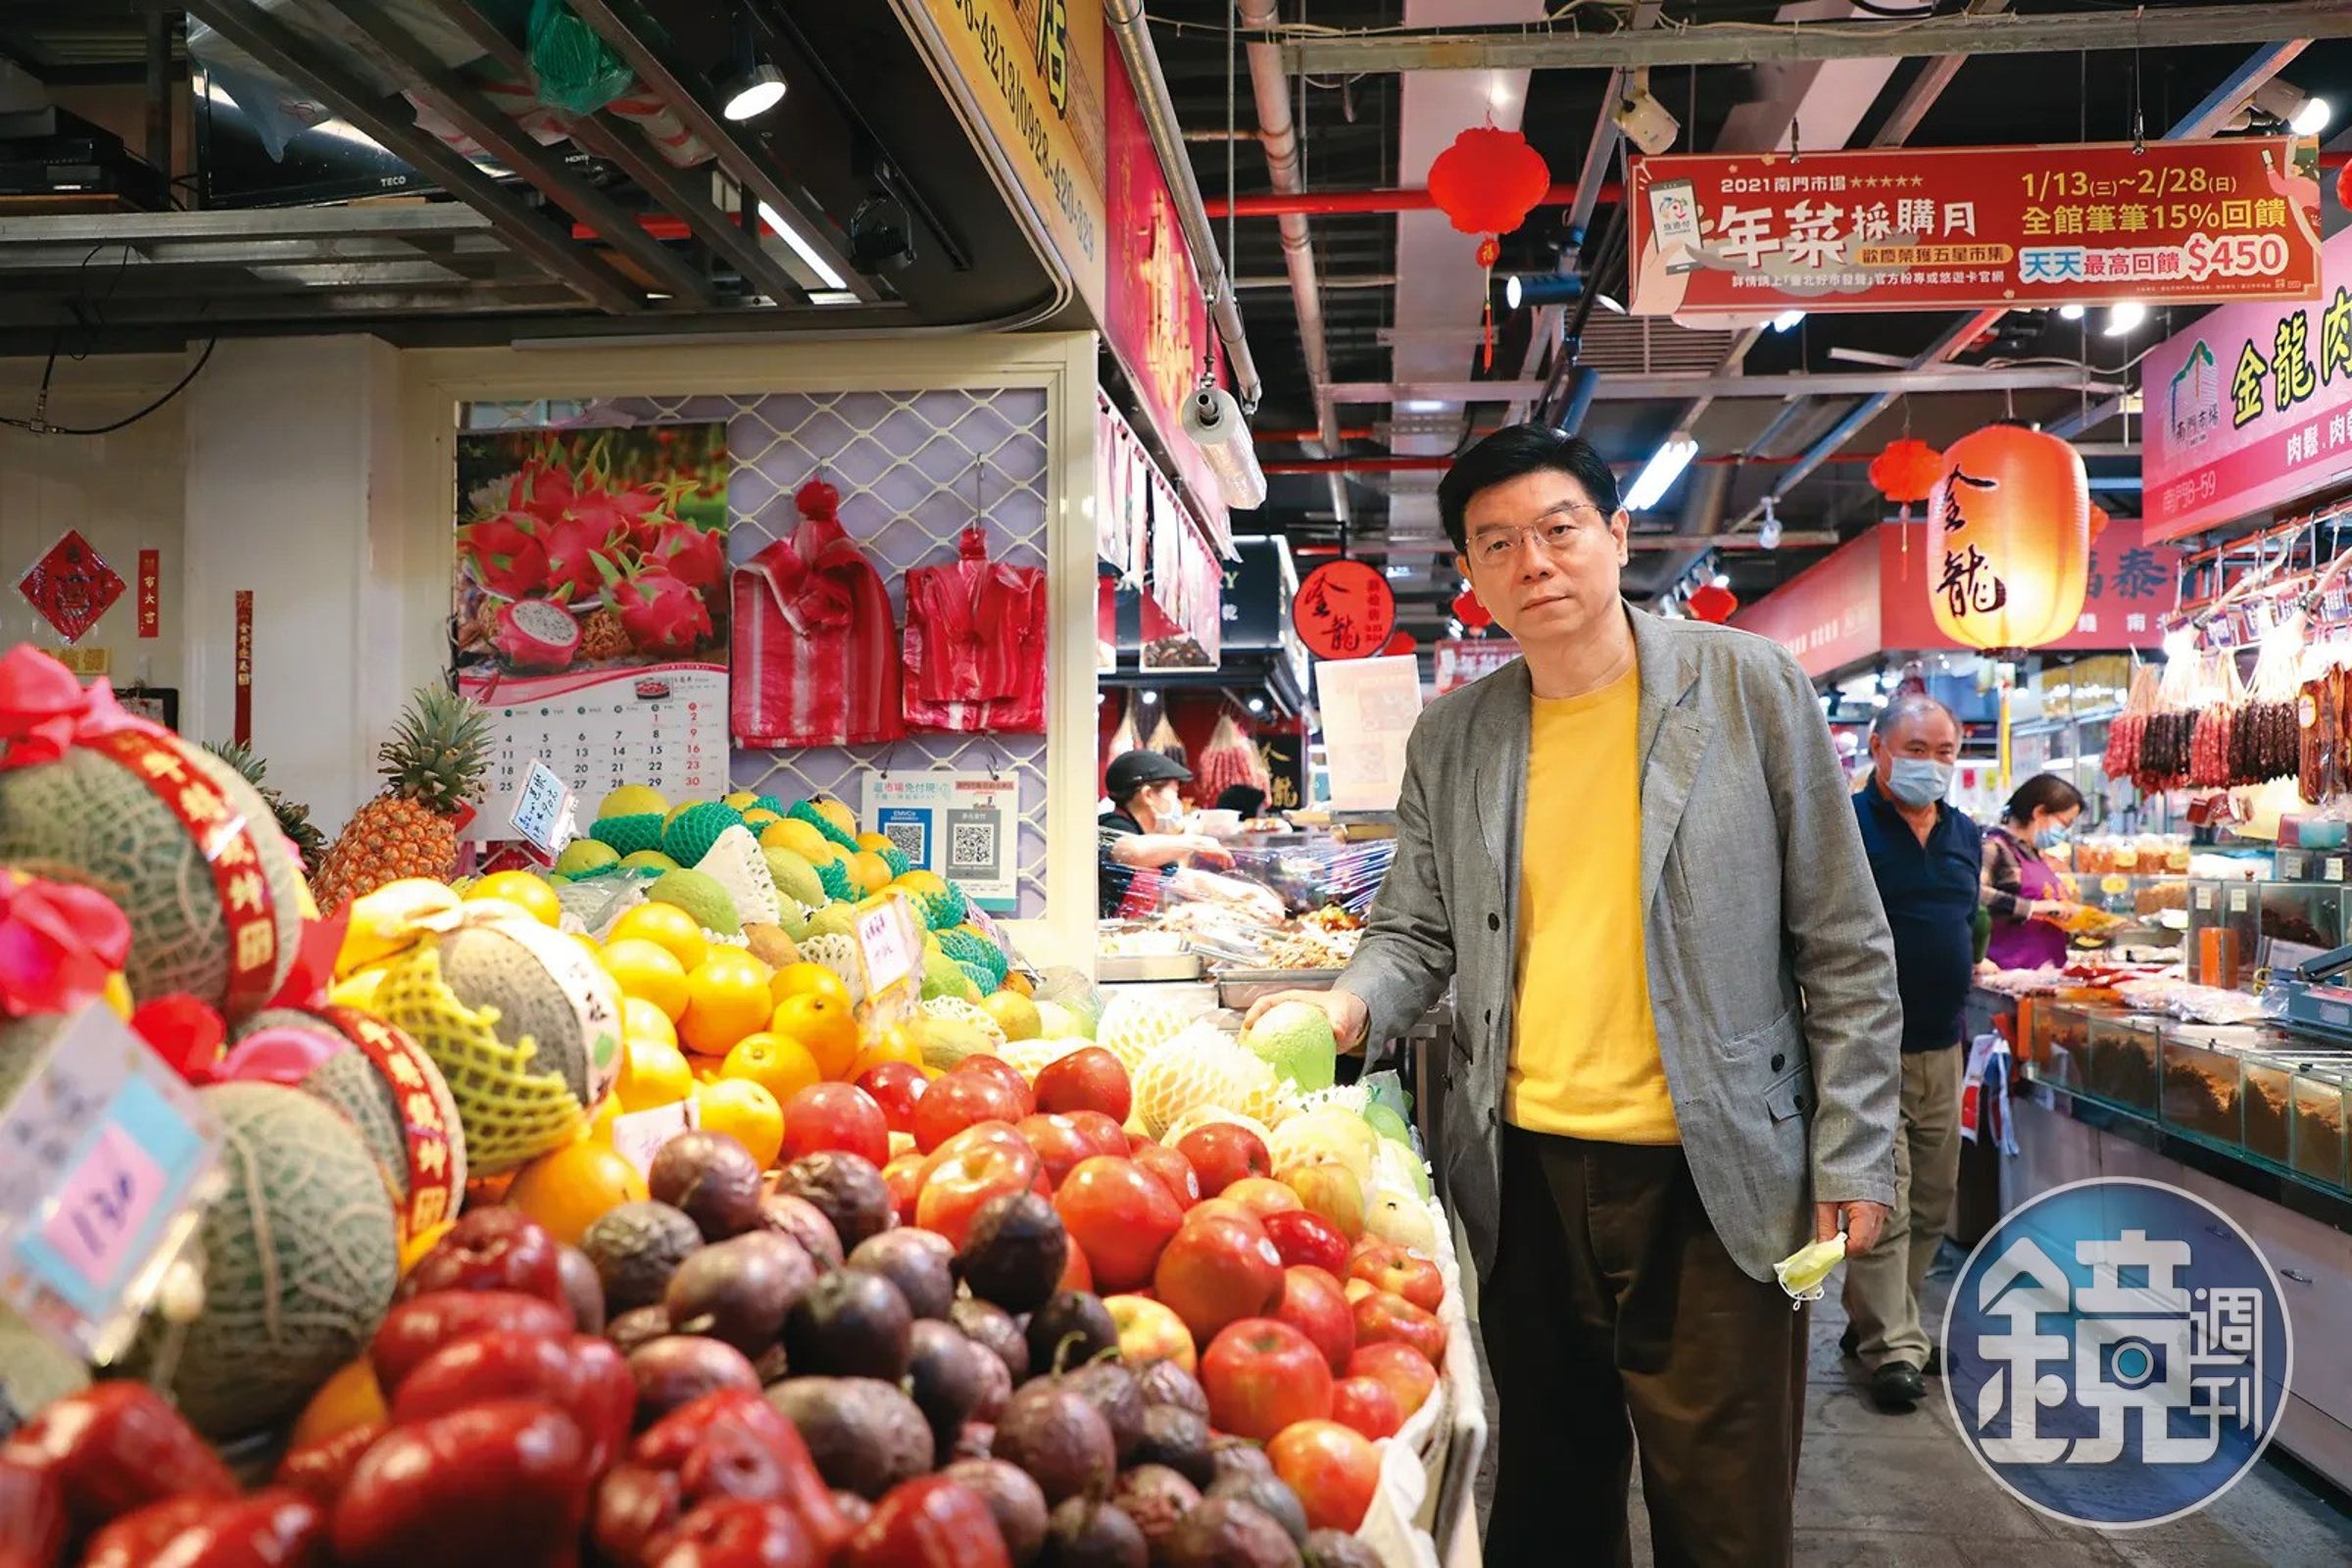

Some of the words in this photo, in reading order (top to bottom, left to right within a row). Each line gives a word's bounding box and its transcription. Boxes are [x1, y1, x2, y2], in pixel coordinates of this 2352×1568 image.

[380, 175, 407, 186] TECO
[1720, 174, 1846, 193] 2021南門市場
[2022, 198, 2286, 235] 全館筆筆15%回饋
[1936, 464, 2007, 617] 金龍
[690, 712, 698, 721] 2
[505, 734, 513, 743] 4
[542, 733, 550, 743] 5
[577, 732, 586, 742] 6
[614, 730, 622, 740] 7
[652, 729, 660, 739] 8
[690, 728, 698, 737] 9
[502, 751, 514, 760] 11
[539, 750, 552, 759] 12
[575, 748, 589, 758] 13
[612, 747, 626, 756] 14
[650, 746, 662, 755] 15
[687, 745, 700, 754] 16
[501, 766, 514, 775] 18
[574, 764, 588, 773] 20
[612, 763, 624, 772] 21
[648, 761, 662, 771] 22
[686, 760, 700, 770] 23
[500, 782, 513, 792] 25
[574, 780, 588, 790] 27
[611, 778, 624, 788] 28
[648, 778, 662, 788] 29
[686, 777, 700, 786] 30
